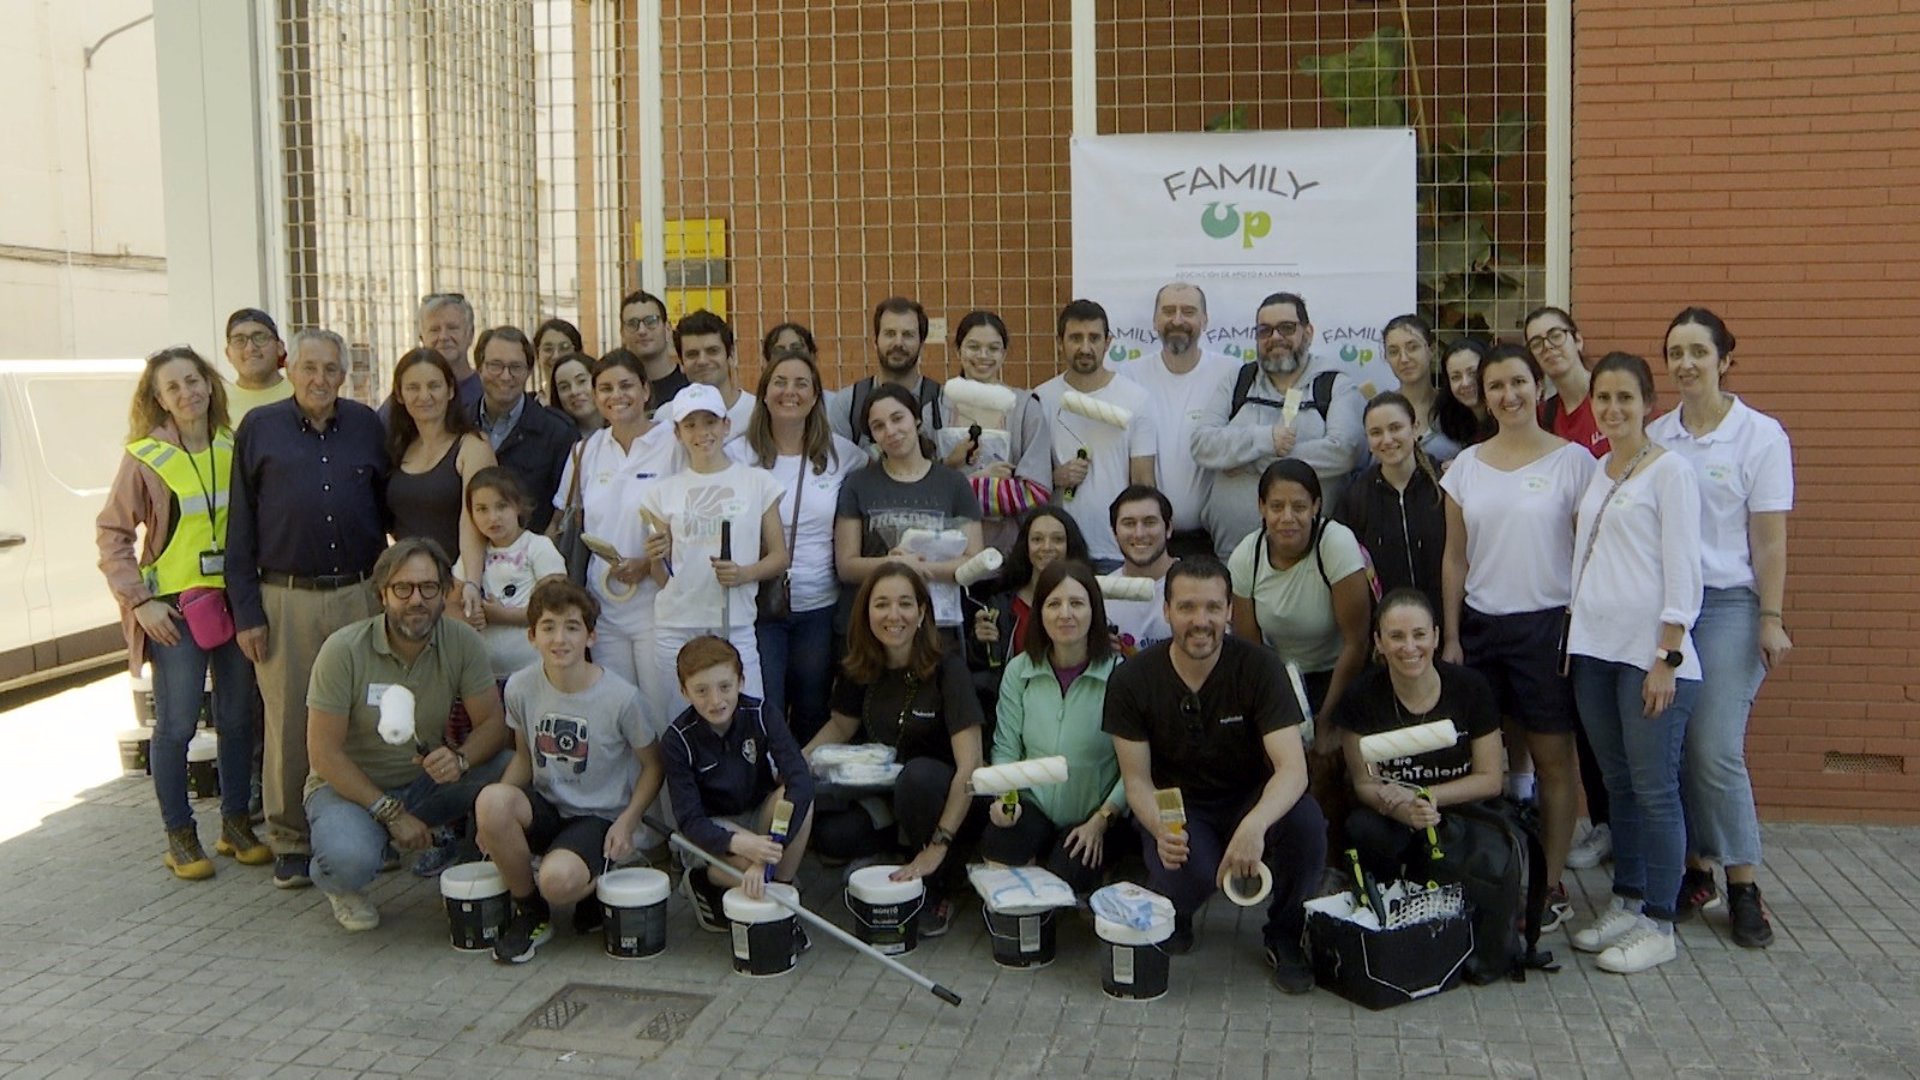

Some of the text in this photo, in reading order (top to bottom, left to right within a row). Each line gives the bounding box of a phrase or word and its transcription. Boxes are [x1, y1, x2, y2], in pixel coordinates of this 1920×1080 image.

[1163, 163, 1320, 201] FAMILY
[1322, 326, 1382, 345] FAMIL
[1381, 761, 1471, 780] echTalent
